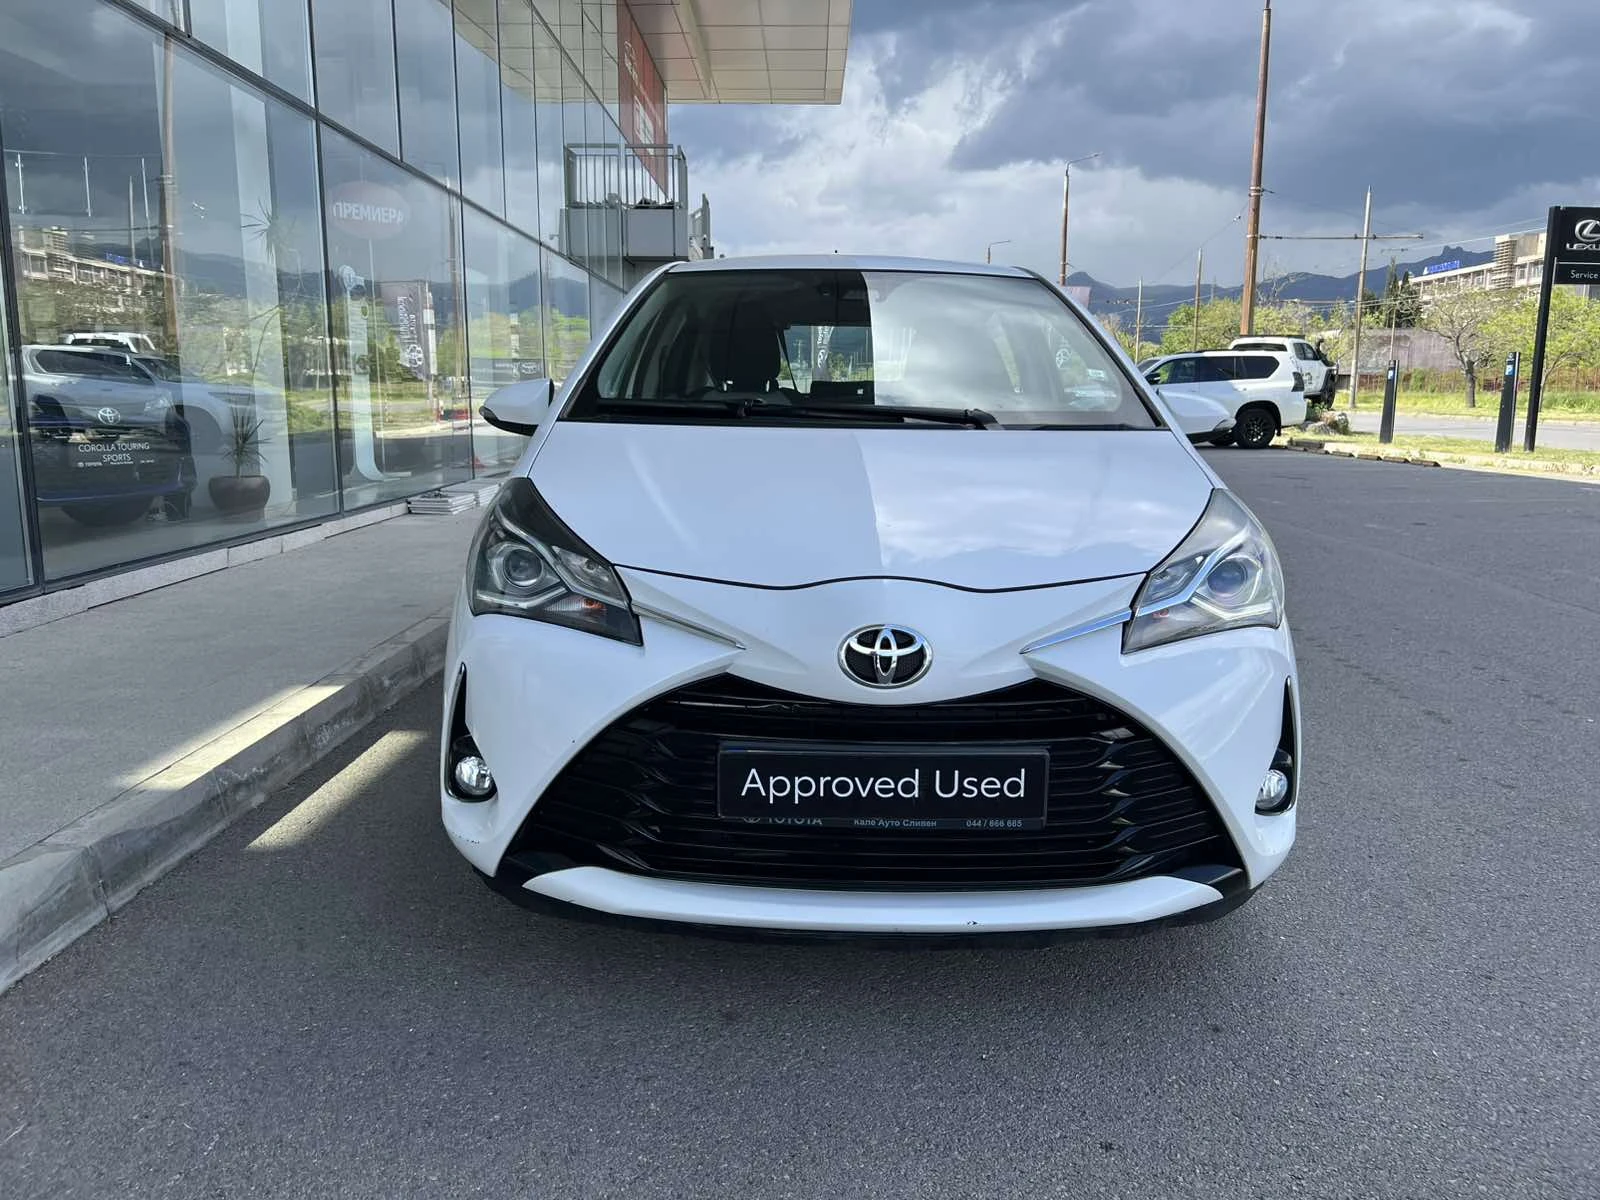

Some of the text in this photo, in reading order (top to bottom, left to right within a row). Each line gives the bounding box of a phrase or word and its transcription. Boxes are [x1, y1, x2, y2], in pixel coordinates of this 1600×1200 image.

[333, 202, 407, 227] ПРЕМИЕРА
[1570, 270, 1599, 279] Service
[78, 441, 150, 453] COROLLA TOURING
[102, 453, 132, 462] SPORTS
[741, 768, 1026, 804] Approved Used
[878, 818, 900, 828] Ауто
